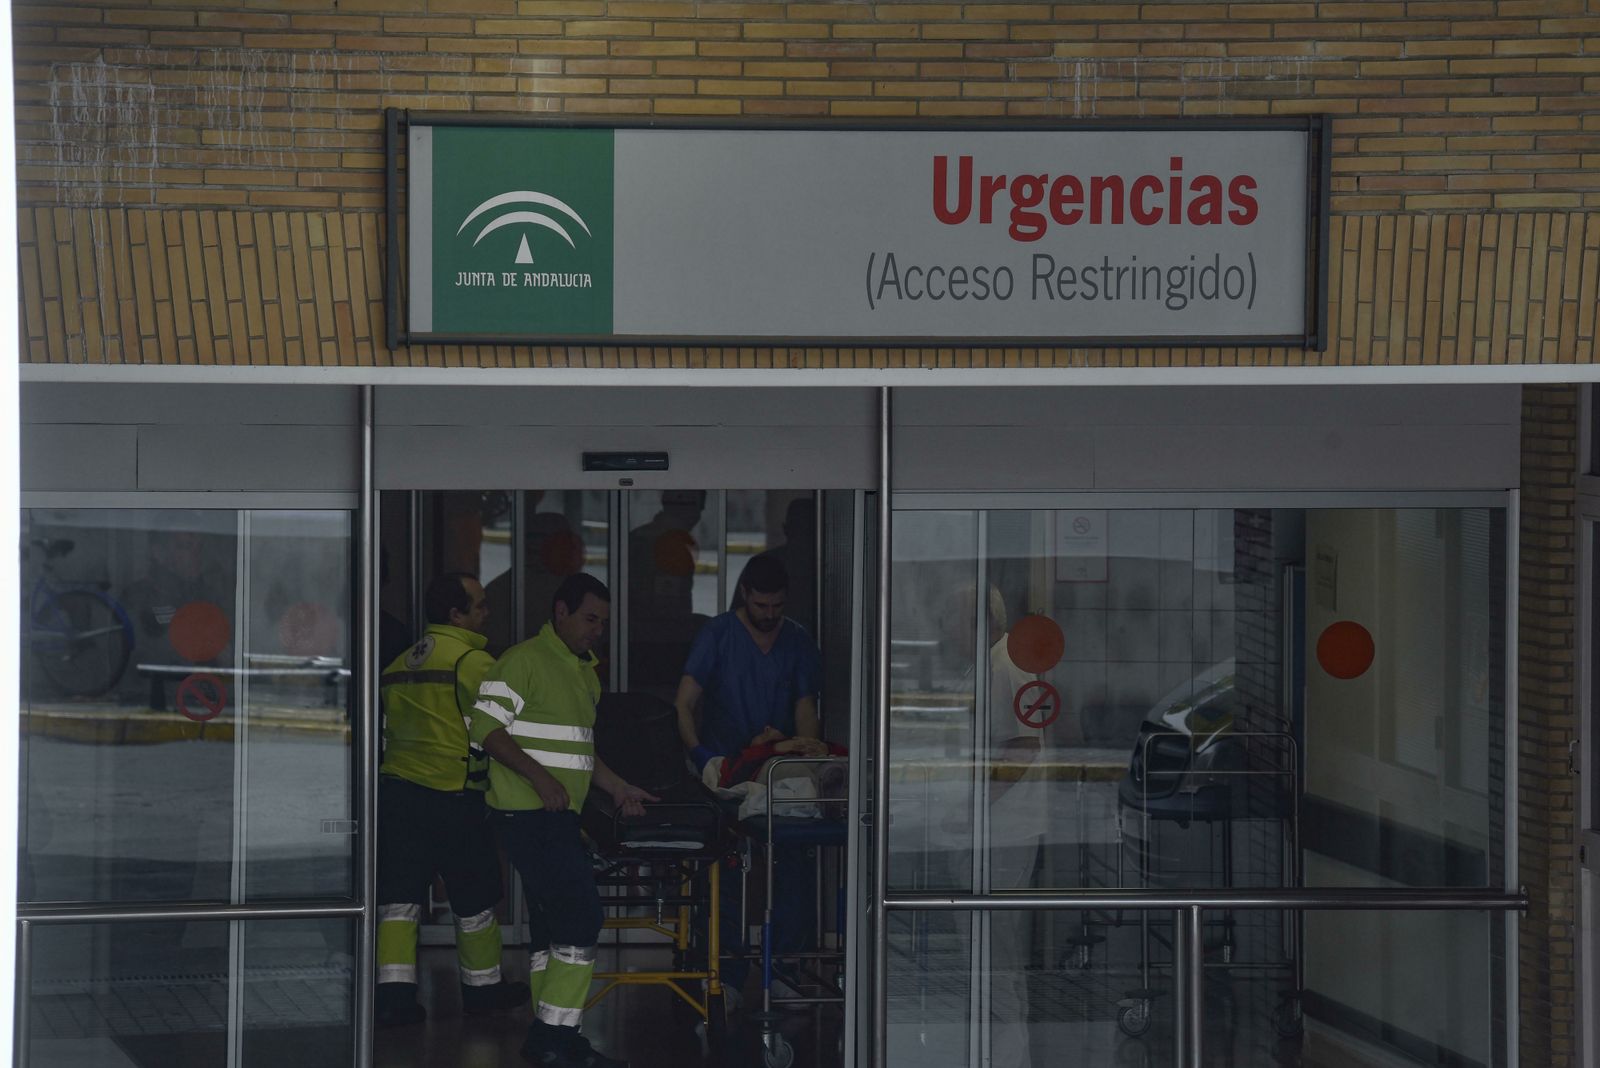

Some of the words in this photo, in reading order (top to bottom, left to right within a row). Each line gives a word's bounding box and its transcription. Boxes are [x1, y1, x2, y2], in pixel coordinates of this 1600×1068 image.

[933, 155, 1259, 242] Urgencias
[455, 271, 496, 287] JUNTA
[502, 271, 518, 287] DE
[524, 272, 593, 288] ANDALUCIA
[866, 252, 1015, 311] (Acceso
[1031, 252, 1257, 311] Restringido)
